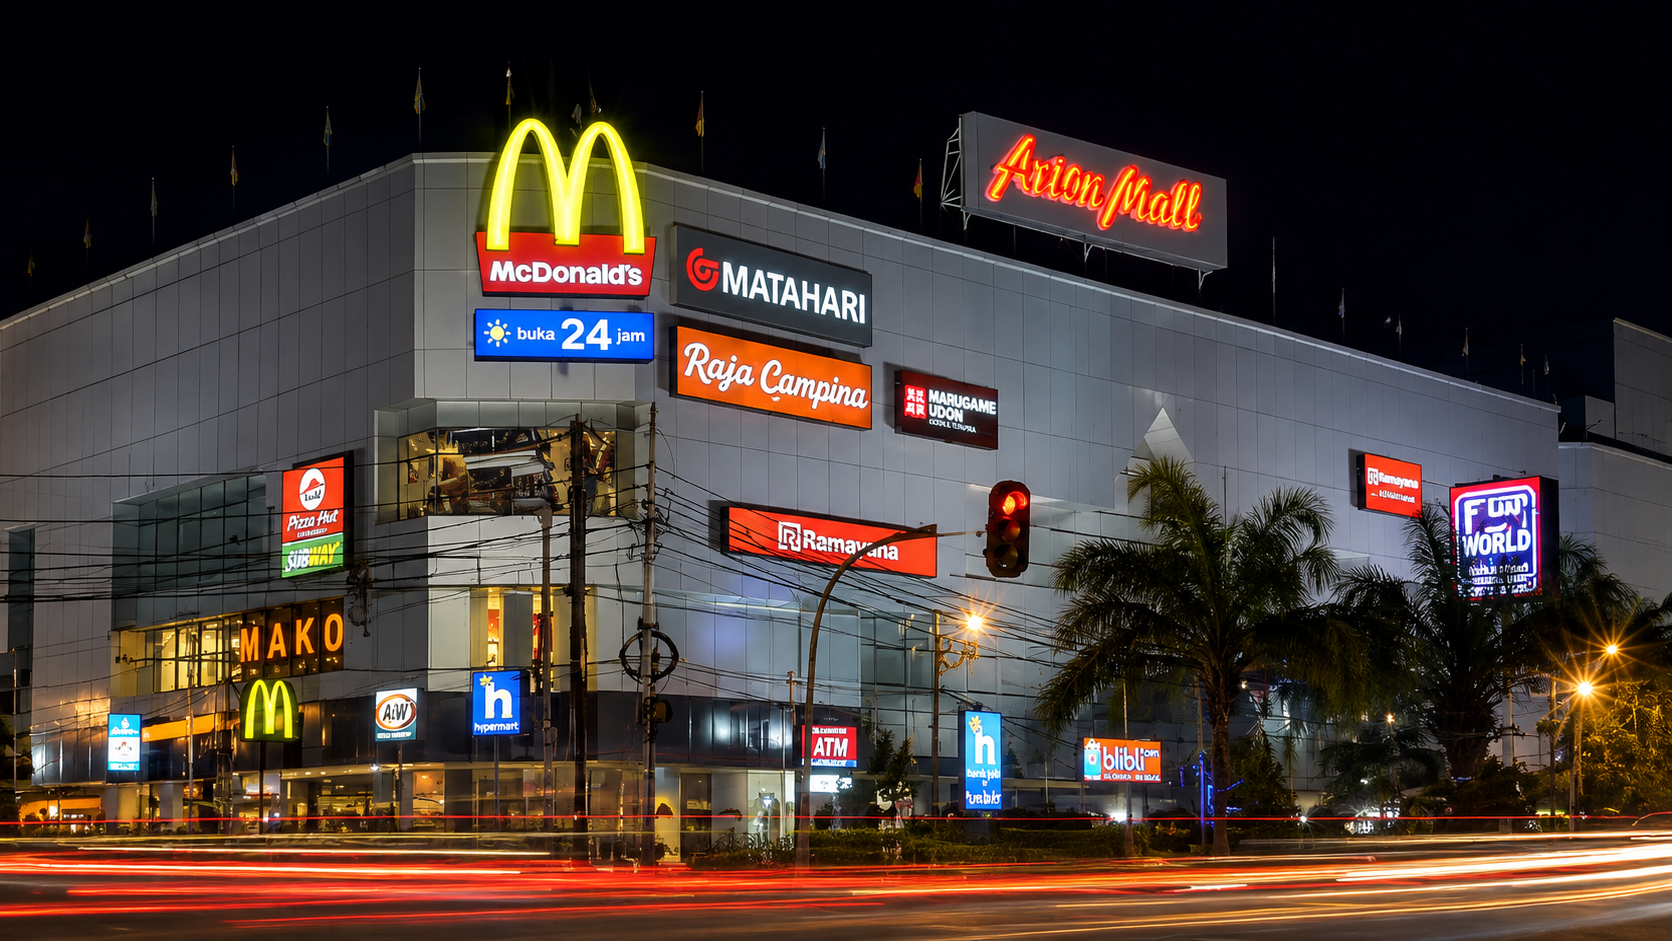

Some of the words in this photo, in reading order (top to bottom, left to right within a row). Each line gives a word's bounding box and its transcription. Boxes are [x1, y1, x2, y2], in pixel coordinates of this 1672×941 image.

[985, 134, 1105, 211] Arion
[1097, 165, 1202, 232] Mall
[489, 260, 643, 286] McDonald's
[722, 261, 866, 325] MATAHARI
[517, 327, 556, 341] buka
[561, 318, 612, 351] 24
[616, 328, 645, 345] jam
[683, 342, 755, 392] Raja
[760, 359, 868, 410] Campina
[928, 388, 997, 415] MARUGAME
[928, 403, 964, 423] UDON
[287, 514, 315, 532] Pizza
[316, 509, 340, 527] Hut
[284, 541, 341, 573] SUBWAY
[1462, 529, 1531, 557] WORLD
[240, 613, 343, 662] MAKO
[474, 722, 519, 733] hypermart
[813, 736, 848, 757] ATM
